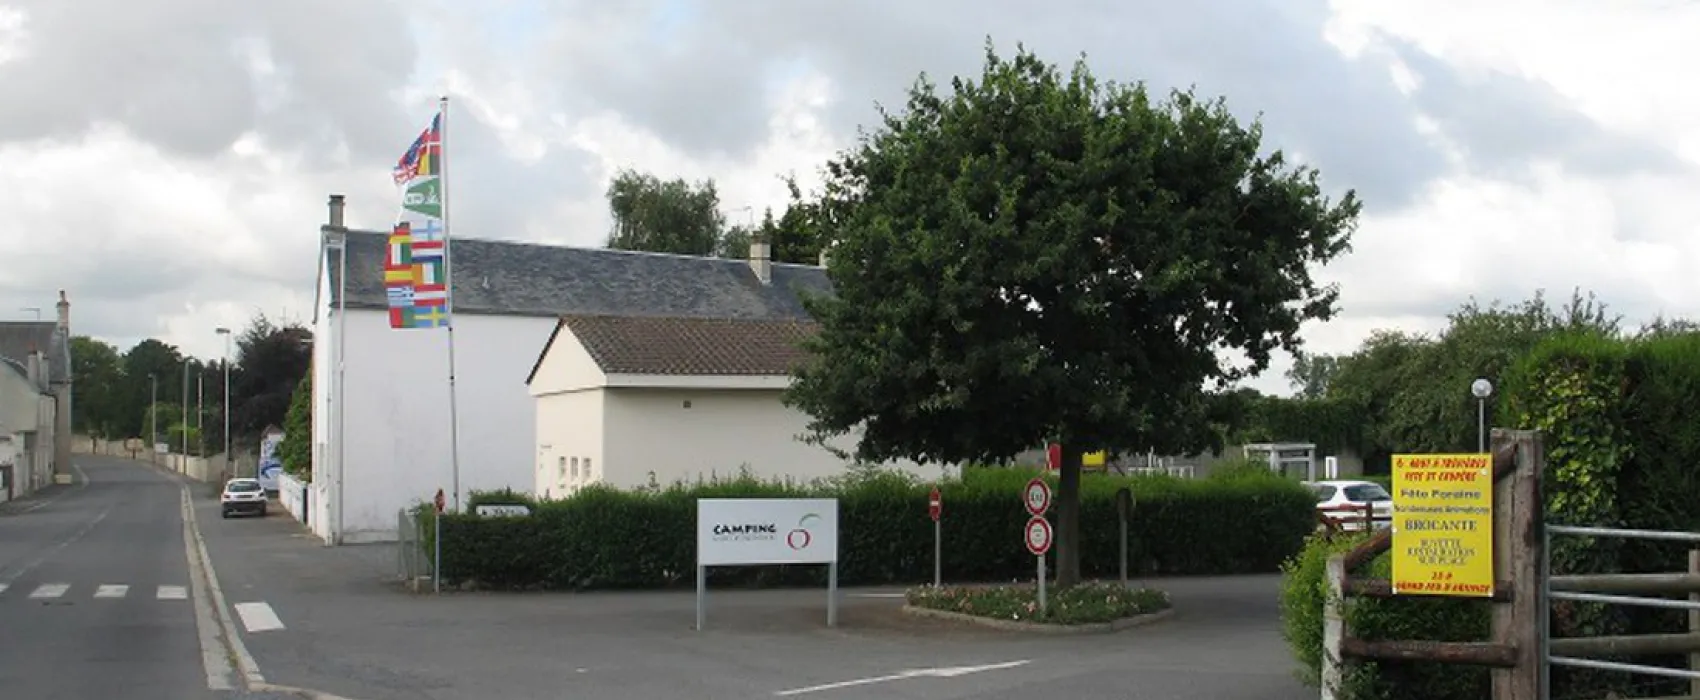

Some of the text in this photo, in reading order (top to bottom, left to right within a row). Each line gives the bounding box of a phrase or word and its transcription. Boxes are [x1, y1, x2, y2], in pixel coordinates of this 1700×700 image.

[1432, 488, 1482, 499] Foraine
[713, 523, 777, 535] CAMPING
[1404, 519, 1478, 530] BROCANTE
